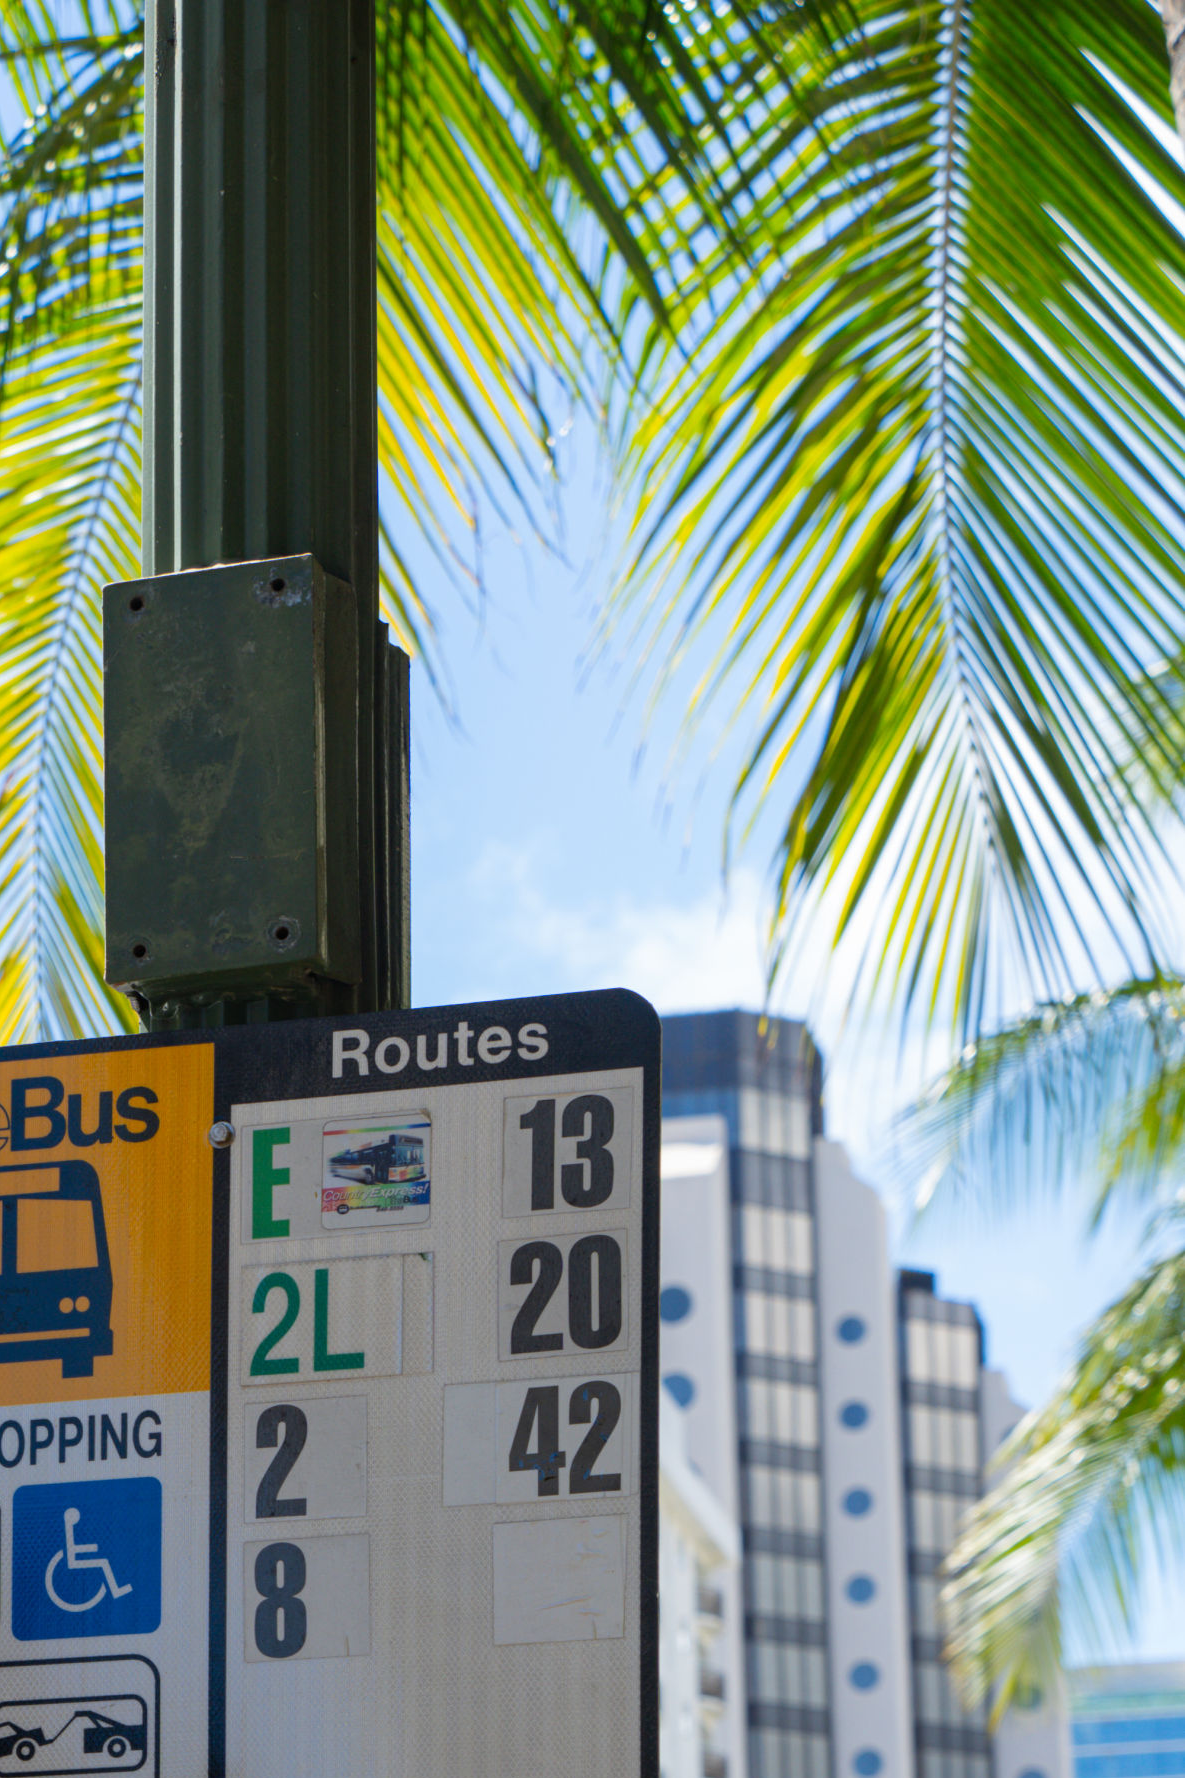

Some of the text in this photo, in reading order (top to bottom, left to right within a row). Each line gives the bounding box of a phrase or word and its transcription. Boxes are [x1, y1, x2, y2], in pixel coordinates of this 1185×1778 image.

[332, 1022, 549, 1078] Routes
[252, 1127, 290, 1239] E
[520, 1094, 614, 1211] 13
[250, 1269, 365, 1376] 2L
[510, 1235, 622, 1354] 20
[256, 1404, 307, 1519] 2
[508, 1381, 621, 1496] 42
[255, 1542, 307, 1658] 8
